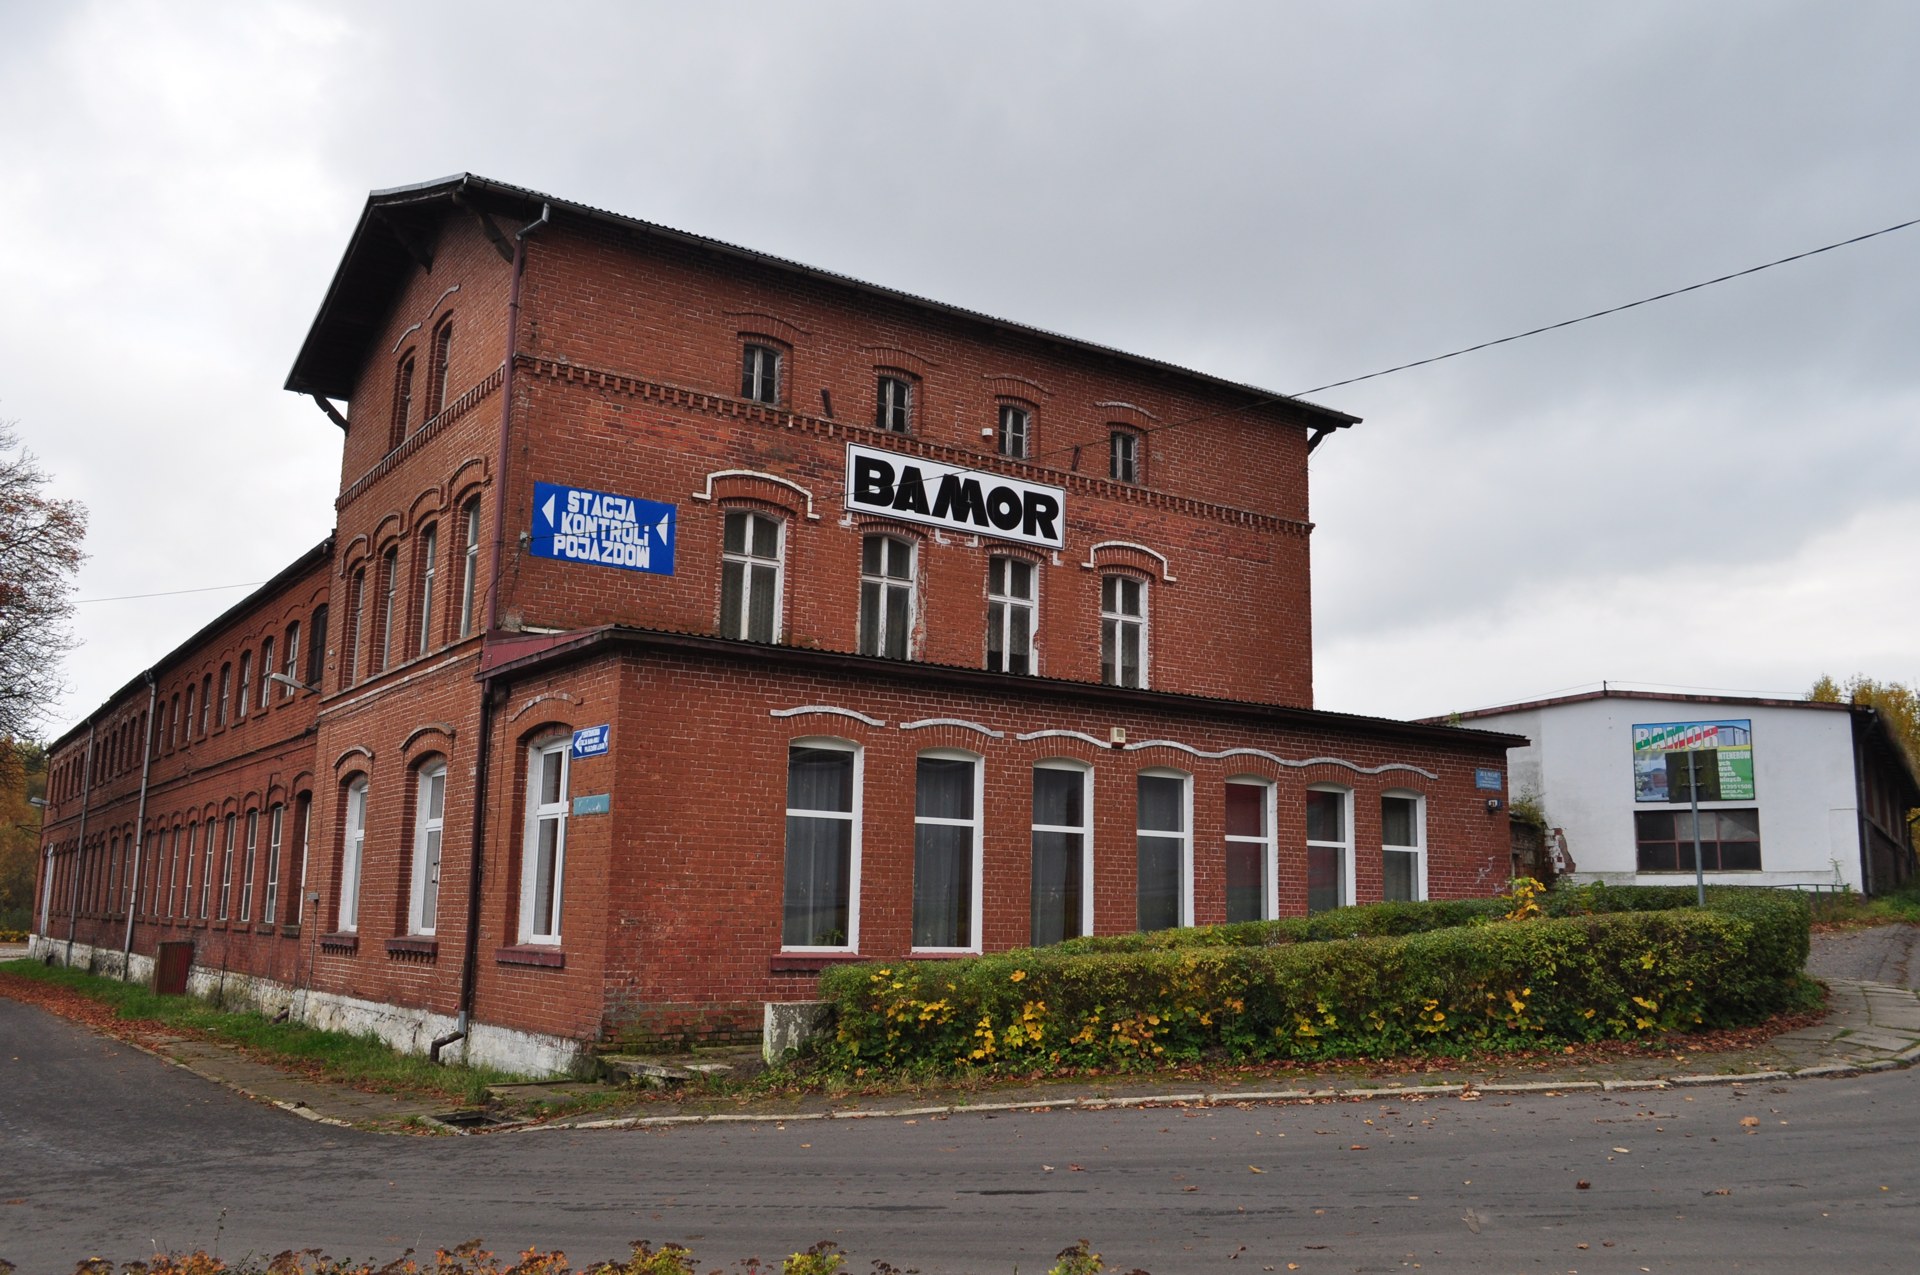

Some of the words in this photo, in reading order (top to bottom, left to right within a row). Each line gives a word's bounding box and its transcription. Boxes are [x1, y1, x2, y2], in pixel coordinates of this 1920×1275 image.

[567, 490, 636, 522] STACJA
[854, 455, 1059, 541] BAMOR
[1635, 725, 1719, 750] BAMOR
